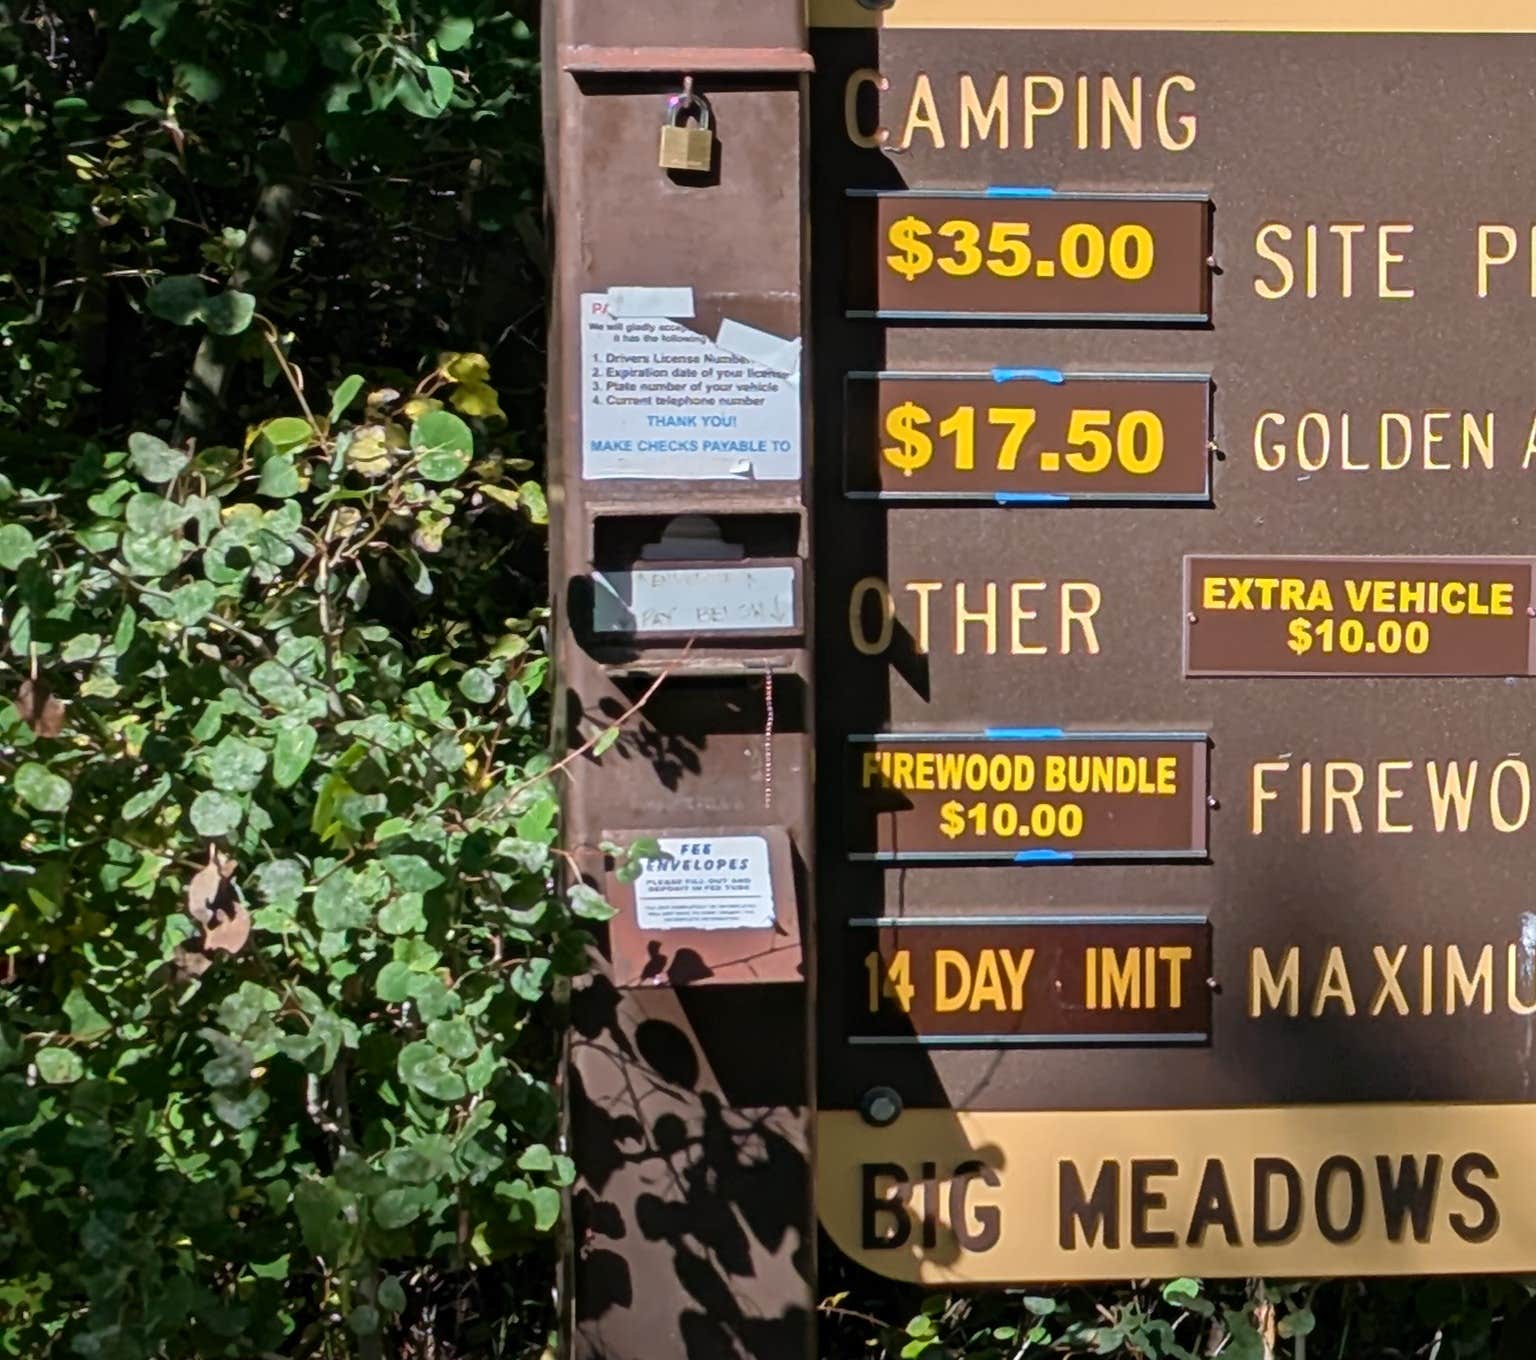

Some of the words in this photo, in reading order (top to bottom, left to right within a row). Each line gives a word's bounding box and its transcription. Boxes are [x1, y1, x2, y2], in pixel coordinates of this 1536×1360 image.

[844, 68, 1198, 151] CAMPING
[886, 216, 1155, 281] $35.00
[1254, 223, 1418, 301] SITE
[606, 353, 649, 364] Drivers
[653, 353, 700, 364] License
[704, 354, 751, 364] Numbe
[606, 367, 668, 381] Expiration
[671, 368, 698, 378] date
[701, 368, 714, 378] of
[716, 370, 743, 382] your
[606, 382, 637, 392] Plate
[640, 382, 686, 392] number
[690, 382, 703, 392] of
[706, 383, 733, 394] your
[736, 382, 779, 393] vehicle
[606, 395, 651, 406] Current
[655, 396, 716, 408] telephone
[719, 397, 765, 406] number
[647, 415, 697, 427] THANK
[702, 415, 737, 428] YOU!
[882, 402, 1165, 477] $17.50
[591, 440, 632, 452] MAKE
[637, 440, 698, 452] CHECKS
[703, 440, 766, 452] PAYABLE
[773, 441, 791, 452] TO
[1254, 410, 1496, 473] GOLDEN
[848, 576, 1101, 655] OTHER
[1202, 576, 1333, 612] EXTRA
[1344, 579, 1514, 616] VEHICLE
[1286, 618, 1430, 655] $10.00
[862, 752, 1035, 792] FIREWOOD
[1045, 756, 1177, 795] BUNDLE
[939, 800, 1084, 839] $10.00
[646, 858, 750, 872] ENVELOPES
[680, 843, 712, 856] FEE
[865, 950, 915, 1013] 14
[934, 948, 1036, 1013] DAY
[860, 1159, 1002, 1253] BIG
[1058, 1151, 1499, 1251] MEADOWS
